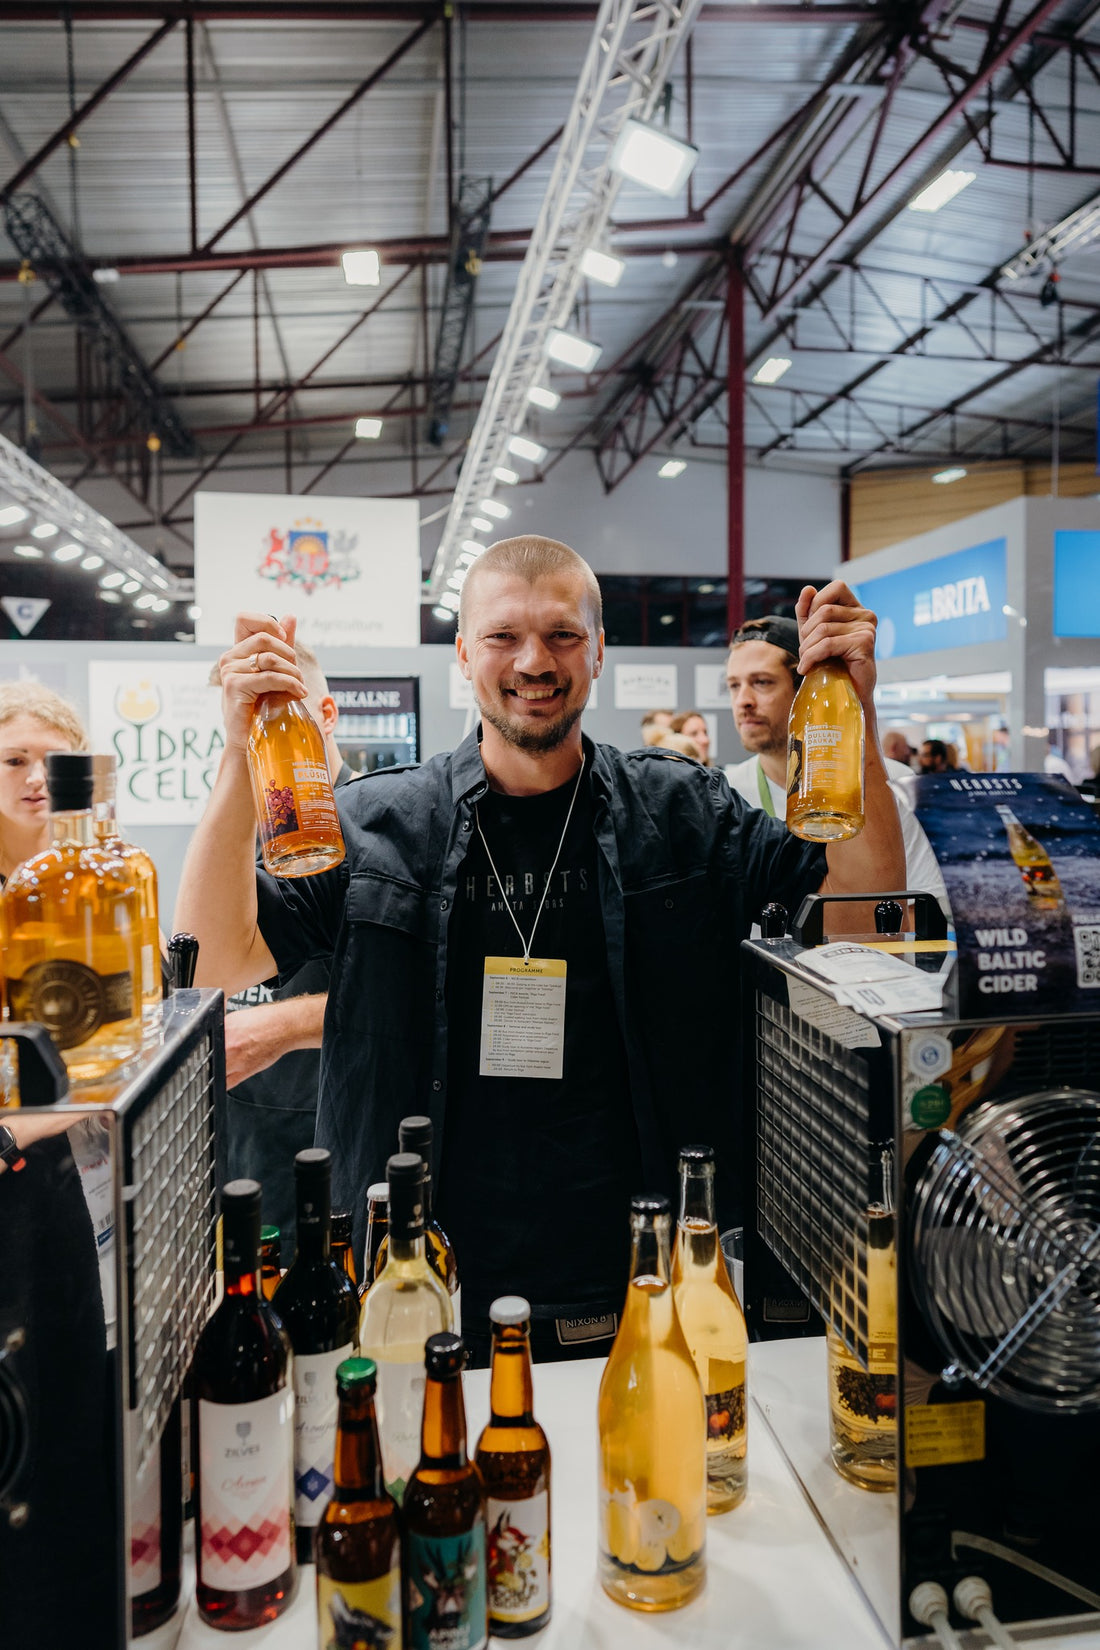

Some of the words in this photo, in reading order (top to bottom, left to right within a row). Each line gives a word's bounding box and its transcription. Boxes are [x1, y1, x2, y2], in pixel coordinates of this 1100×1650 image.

[931, 575, 991, 623] BRITA
[113, 728, 225, 768] SIDRA
[466, 869, 588, 901] HERBSTS
[491, 901, 524, 912] AMTA
[975, 928, 1028, 947] WILD
[978, 950, 1047, 970] BALTIC
[978, 974, 1038, 994] CIDER
